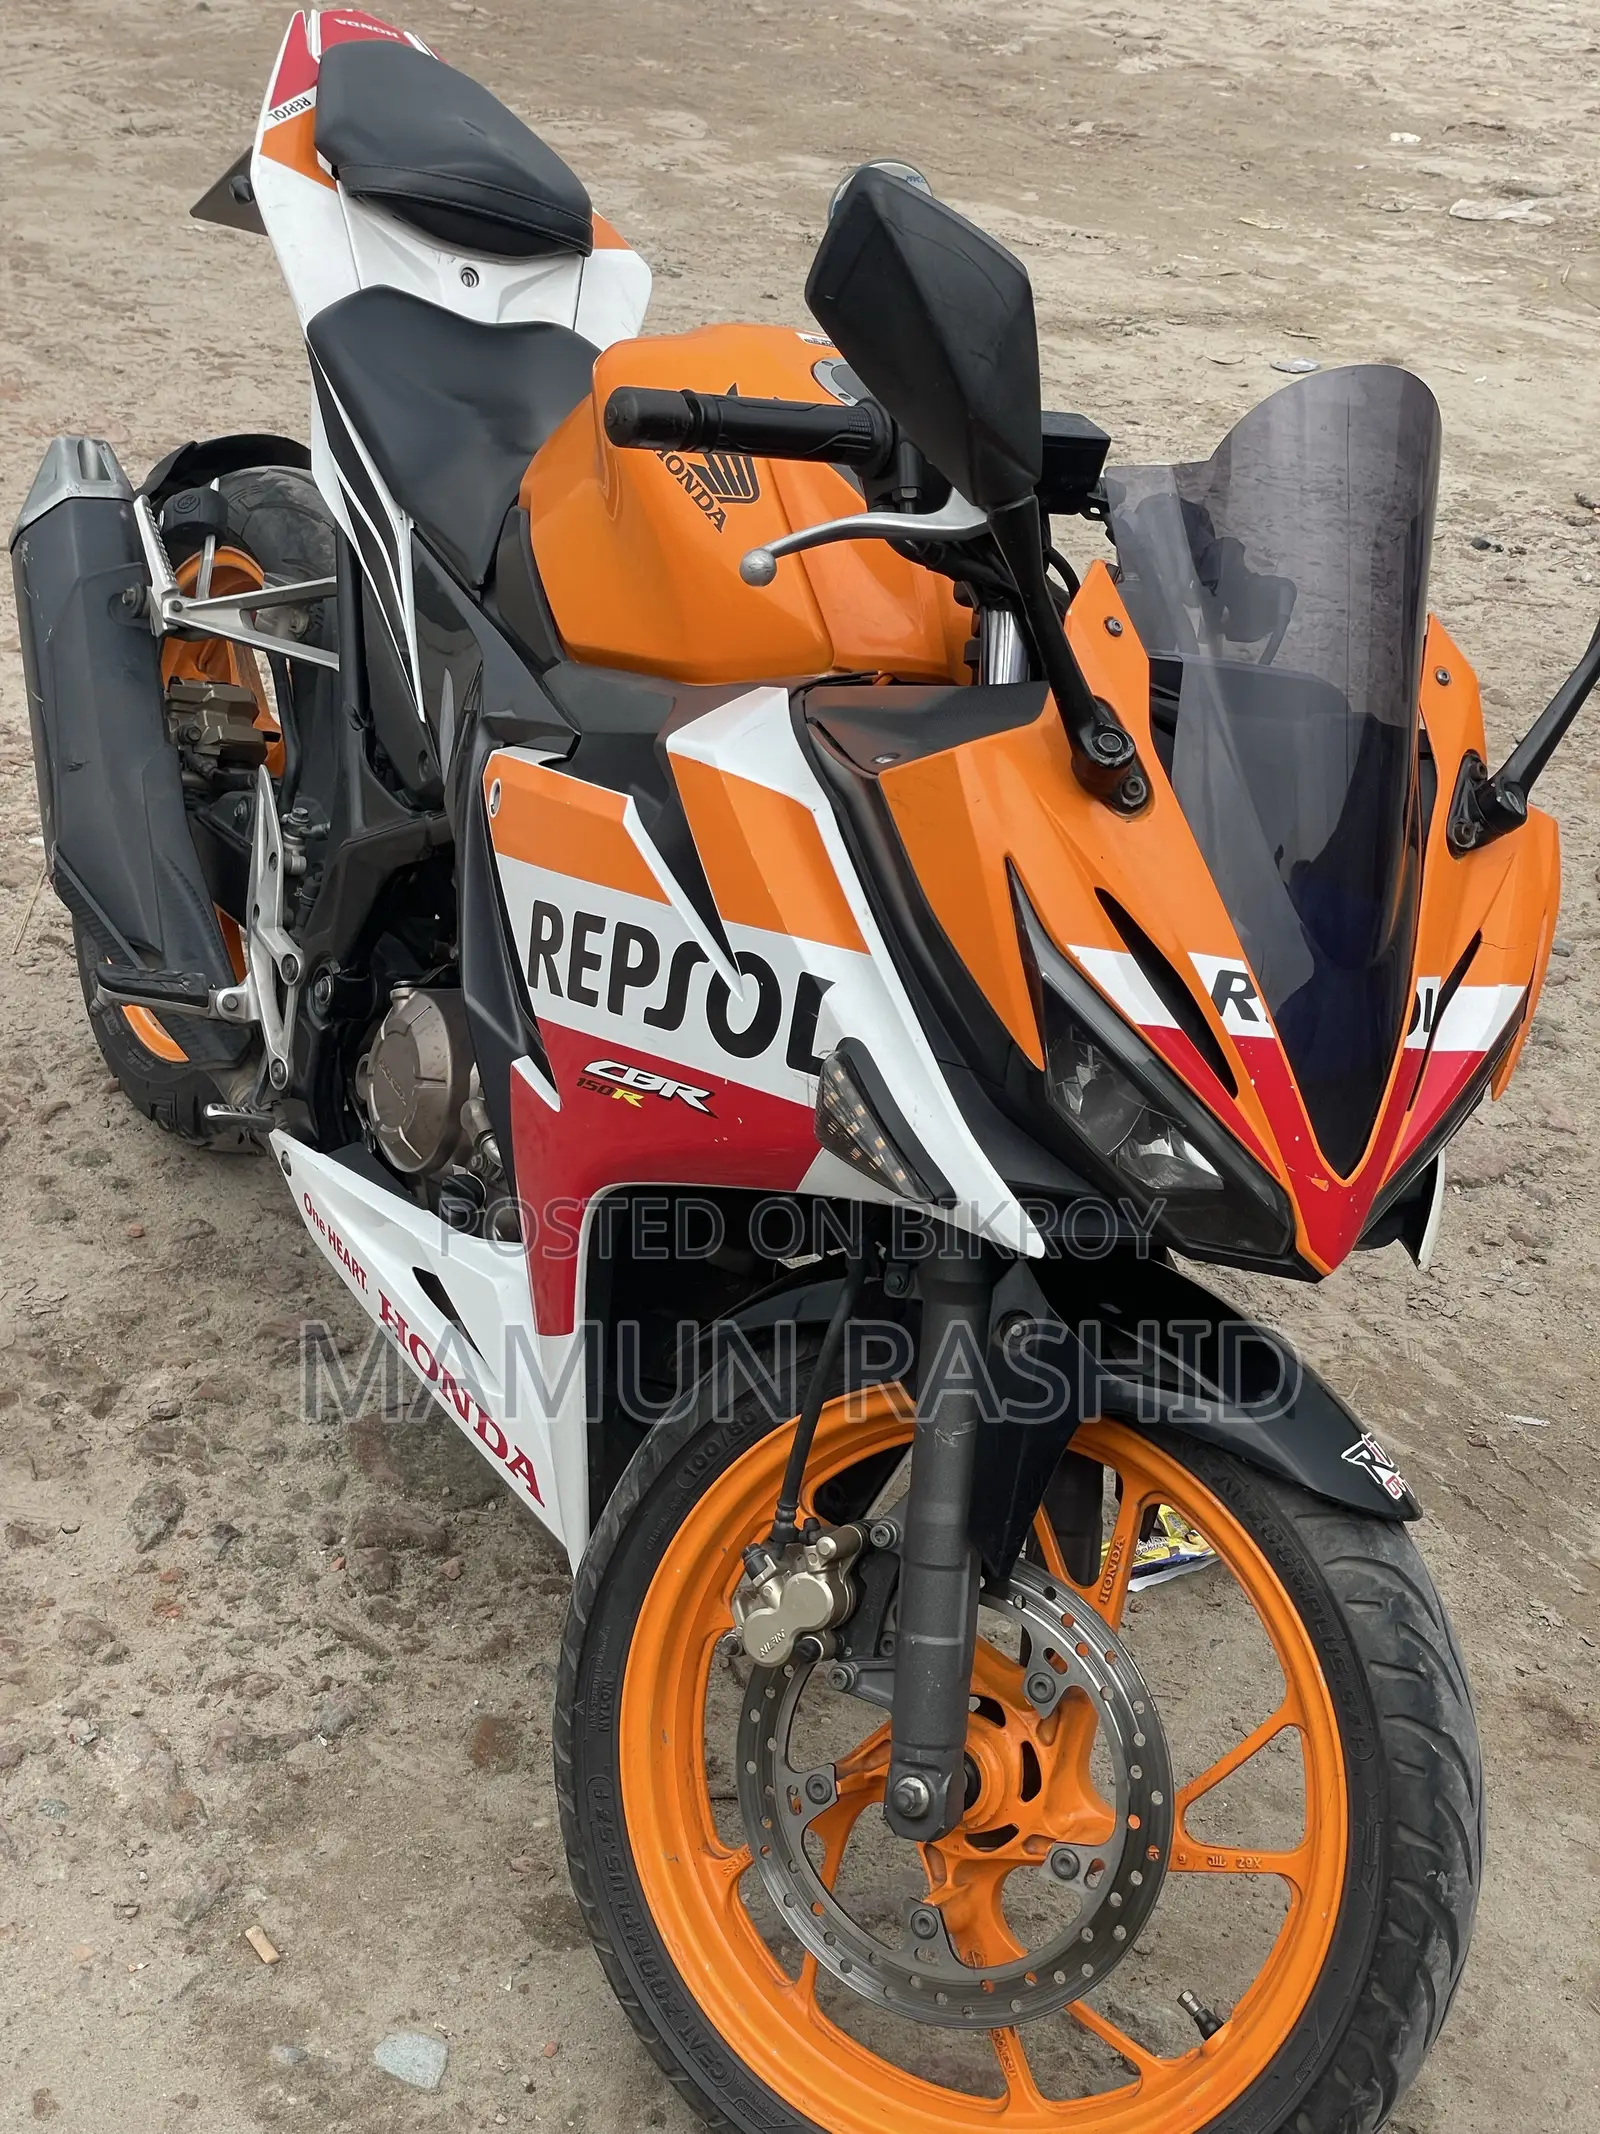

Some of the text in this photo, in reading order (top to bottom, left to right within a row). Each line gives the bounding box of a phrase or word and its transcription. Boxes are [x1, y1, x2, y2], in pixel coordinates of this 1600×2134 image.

[332, 17, 401, 39] HONDA
[267, 96, 312, 122] REPSOL
[527, 898, 837, 1076] REPSOL
[575, 1076, 644, 1109] 150R
[581, 1057, 720, 1119] CBR
[303, 1191, 370, 1295] One HEART.
[377, 1288, 547, 1509] HONDA
[1098, 1535, 1127, 1606] HONDA
[597, 1679, 614, 1733] NYLON
